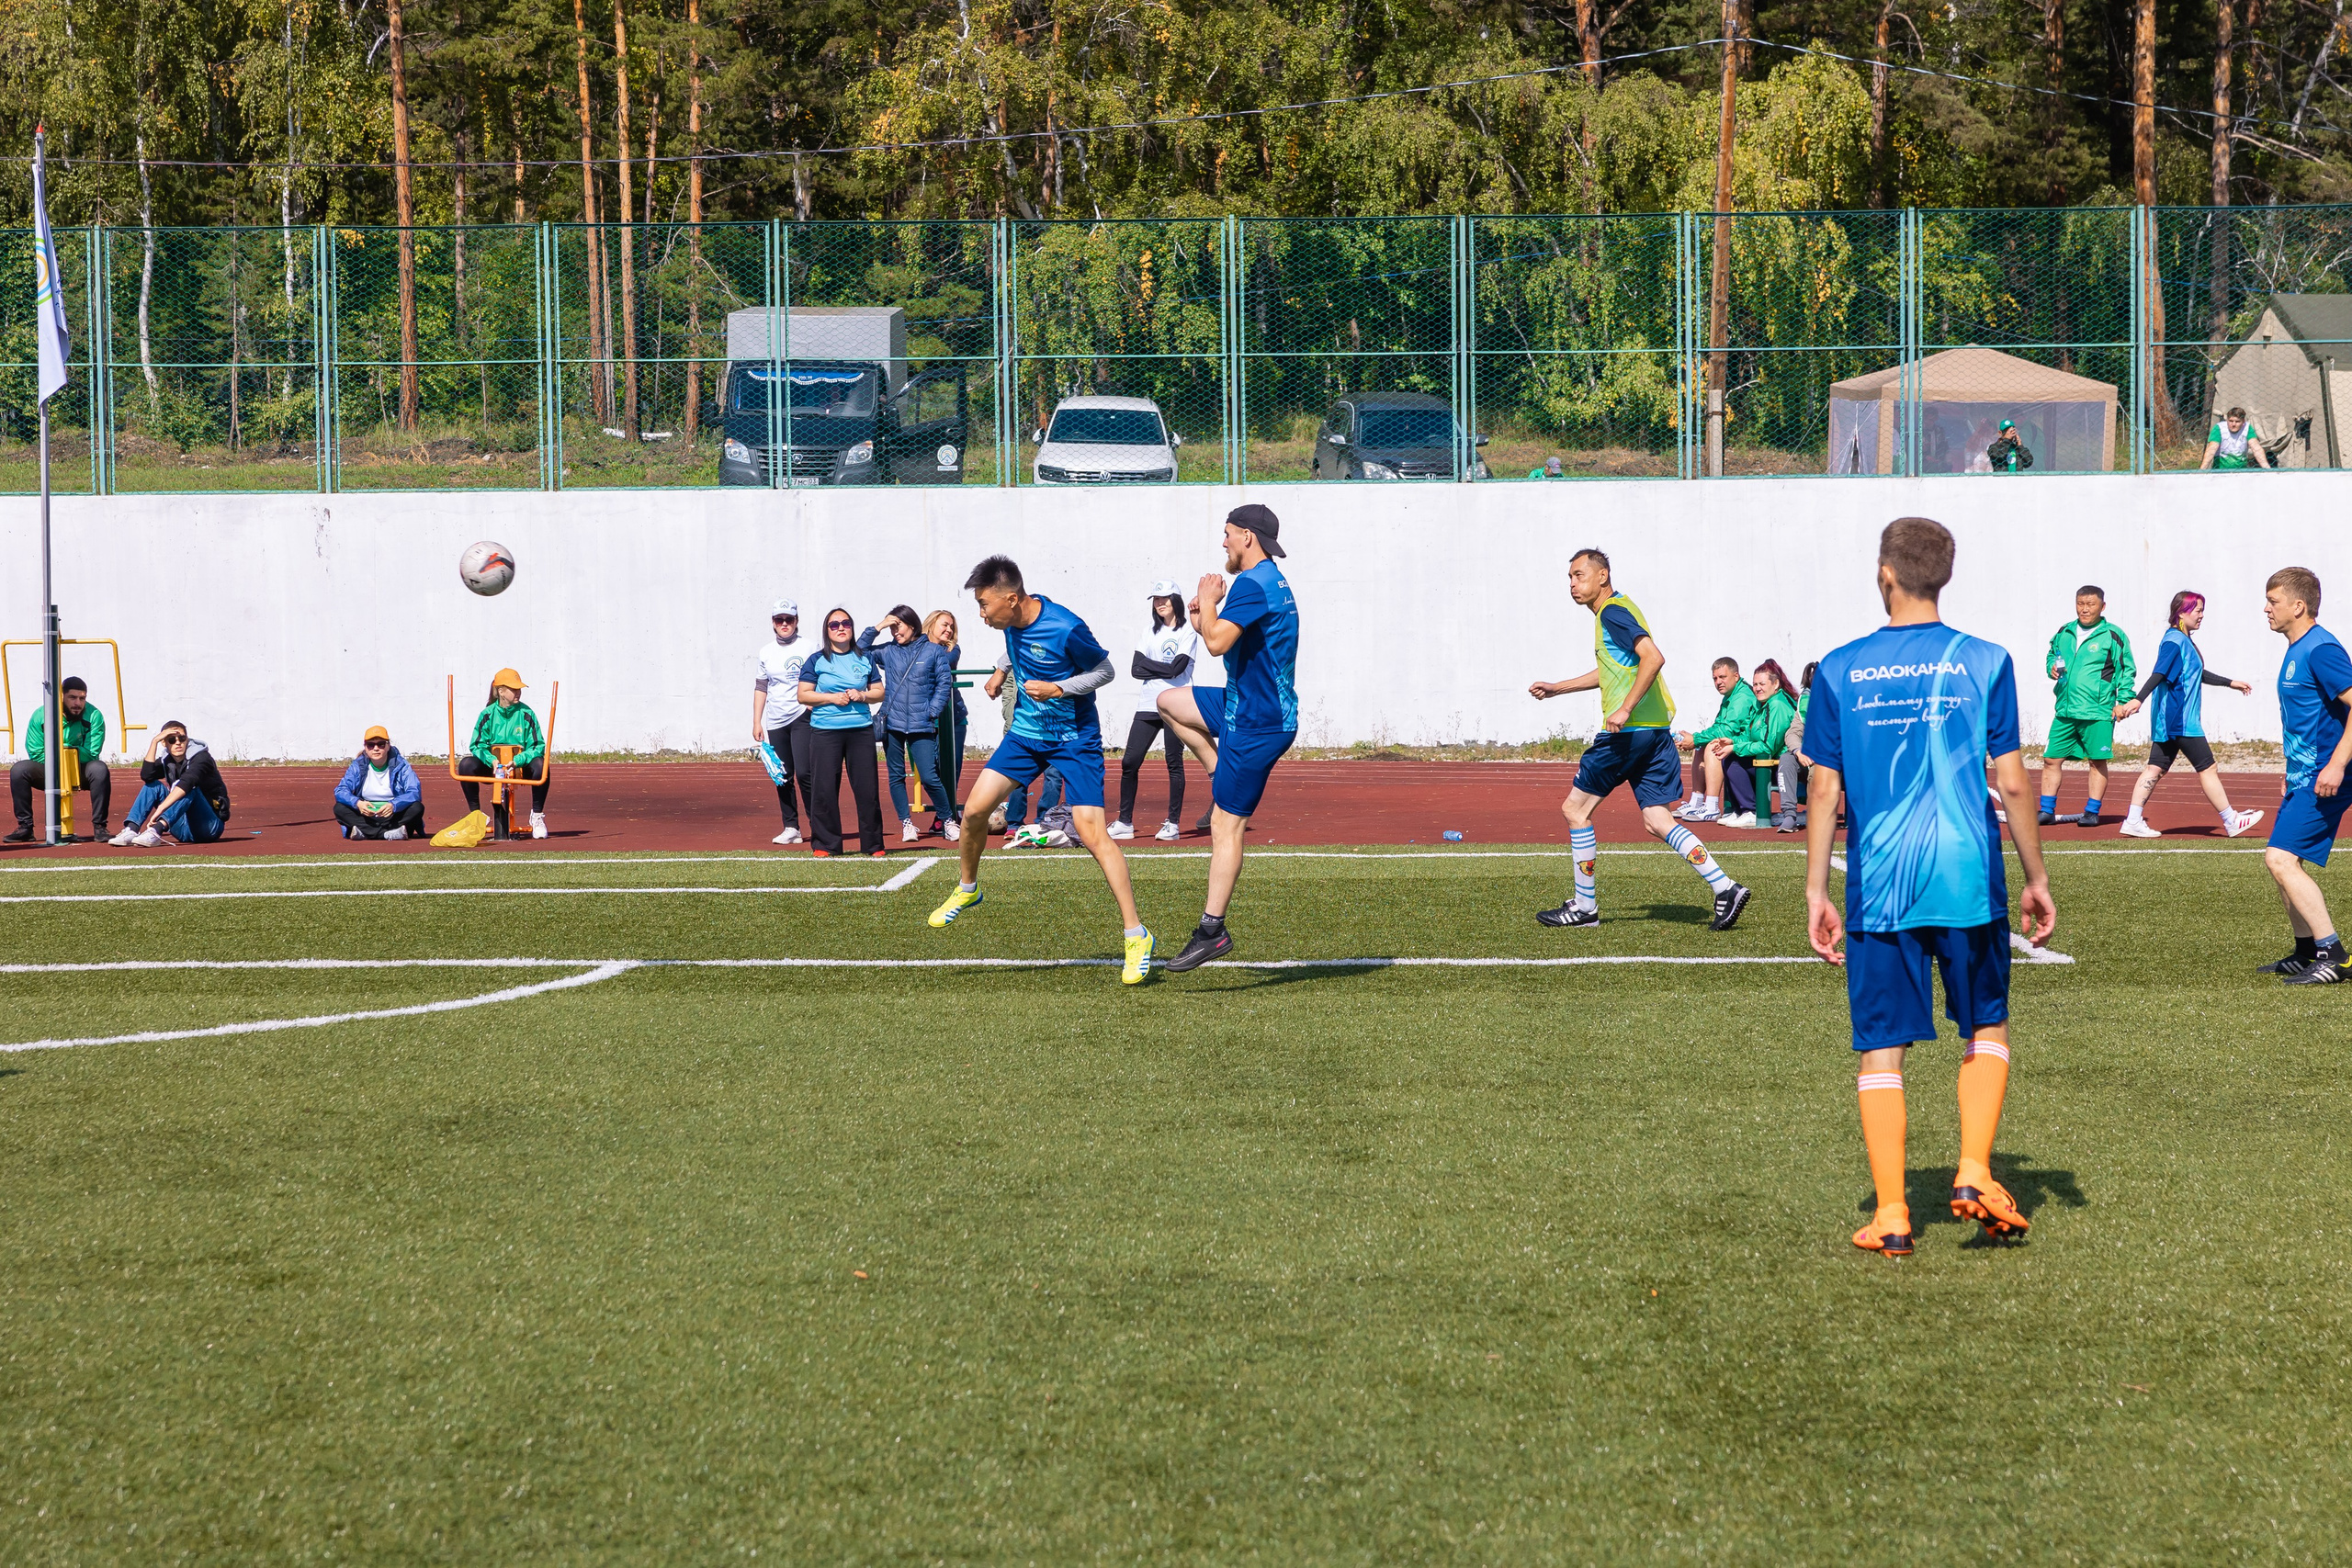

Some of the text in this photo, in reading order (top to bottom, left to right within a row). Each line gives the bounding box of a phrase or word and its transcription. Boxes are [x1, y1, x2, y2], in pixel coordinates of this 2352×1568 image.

[1850, 661, 1968, 682] ВОДОКАНАЛ
[1851, 694, 1923, 711] Любимому
[1867, 717, 1919, 735] чистую
